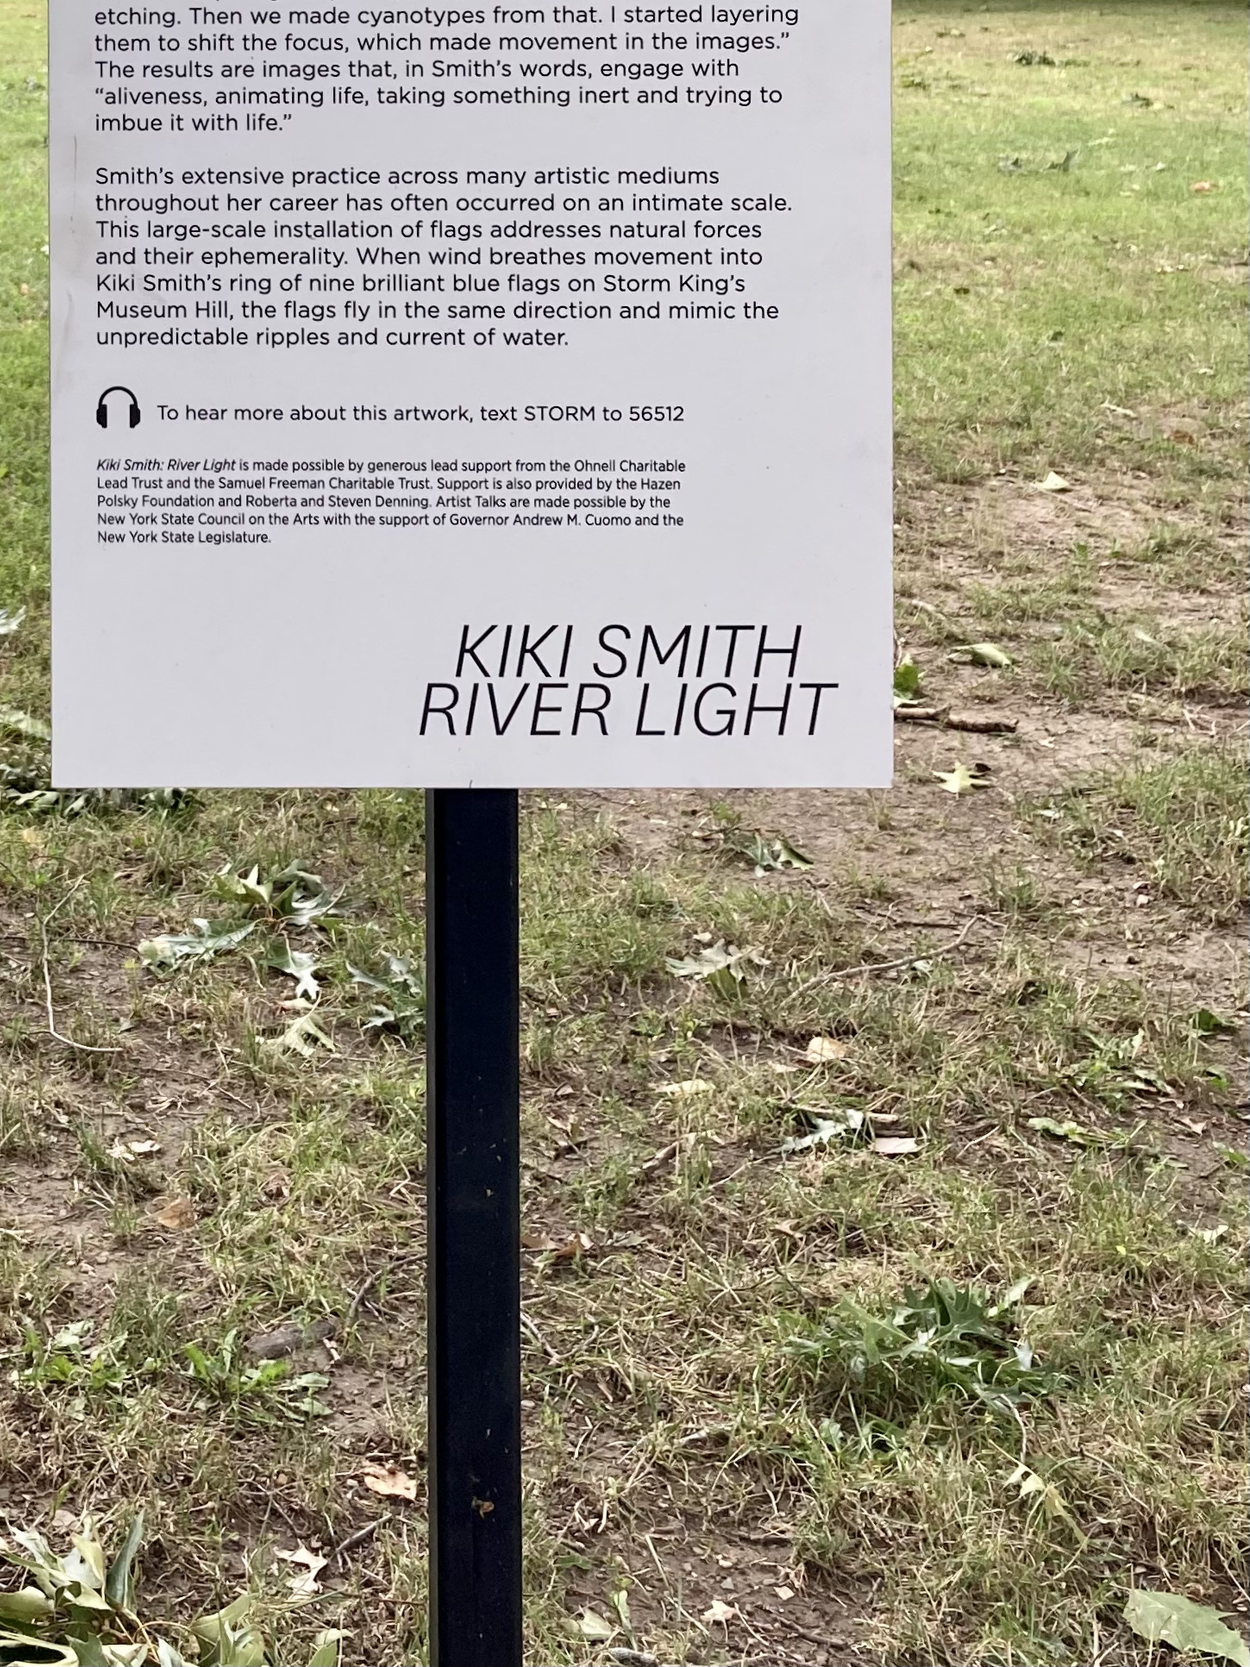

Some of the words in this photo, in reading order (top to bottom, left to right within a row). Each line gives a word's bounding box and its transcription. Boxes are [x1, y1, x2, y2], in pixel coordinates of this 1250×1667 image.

[95, 113, 163, 132] imbue
[170, 113, 185, 132] it
[191, 112, 238, 132] with
[95, 193, 220, 215] throughout
[227, 192, 263, 212] her
[269, 197, 339, 212] career
[346, 192, 383, 212] has
[390, 192, 448, 212] often
[455, 192, 555, 212] occurred
[562, 197, 591, 212] on
[597, 197, 624, 212] an
[632, 193, 724, 212] intimate
[730, 192, 792, 212] scale.
[95, 246, 136, 265] and
[143, 246, 195, 265] their
[201, 246, 348, 269] ephemerality.
[355, 246, 421, 265] When
[427, 246, 482, 266] wind
[489, 246, 586, 266] breathes
[594, 248, 713, 266] movement
[720, 246, 763, 266] into
[97, 300, 187, 319] Museum
[195, 300, 234, 321] Hill,
[240, 300, 277, 319] the
[283, 299, 337, 322] flags
[343, 300, 371, 322] fly
[378, 300, 397, 319] in
[404, 300, 440, 319] the
[447, 304, 506, 319] same
[513, 300, 612, 320] direction
[619, 300, 661, 320] and
[668, 300, 736, 320] mimic
[742, 300, 779, 320] the
[96, 326, 249, 349] unpredictable
[256, 326, 330, 349] ripples
[337, 327, 378, 346] and
[385, 328, 466, 346] current
[473, 327, 497, 346] of
[502, 328, 569, 346] water.
[156, 404, 179, 421] To
[185, 404, 228, 421] hear
[234, 408, 284, 421] more
[289, 404, 347, 421] about
[352, 404, 388, 421] this
[393, 404, 474, 424] artwork,
[479, 405, 518, 422] text
[524, 405, 596, 422] STORM
[602, 406, 623, 422] to
[628, 405, 685, 422] 56512
[96, 458, 122, 471] Kiki
[123, 458, 165, 472] Smith:
[167, 458, 202, 472] River
[202, 458, 237, 474] Light
[239, 458, 250, 472] is
[252, 458, 289, 472] made
[291, 458, 345, 474] possible
[348, 458, 365, 474] by
[367, 461, 428, 474] generous
[430, 458, 458, 472] lead
[461, 459, 513, 474] support
[515, 458, 546, 472] from
[549, 459, 571, 472] the
[573, 459, 616, 473] Ohnell
[619, 459, 686, 473] Charitable
[97, 476, 128, 490] Lead
[131, 476, 164, 490] Trust
[166, 476, 191, 490] and
[193, 476, 216, 490] the
[218, 476, 266, 490] Samuel
[269, 476, 326, 490] Freeman
[328, 476, 395, 490] Charitable
[397, 476, 434, 490] Trust.
[436, 476, 490, 492] Support
[492, 477, 503, 490] is
[505, 477, 533, 490] also
[535, 477, 593, 493] provided
[596, 477, 613, 493] by
[615, 477, 638, 491] the
[640, 477, 681, 491] Hazen
[97, 530, 127, 544] New
[128, 530, 158, 544] York
[161, 530, 195, 544] State
[198, 530, 272, 546] Legislature.
[455, 624, 574, 678] KIKI
[592, 623, 803, 679] SMITH
[418, 682, 612, 736] RIVER
[635, 682, 840, 737] LIGHT
